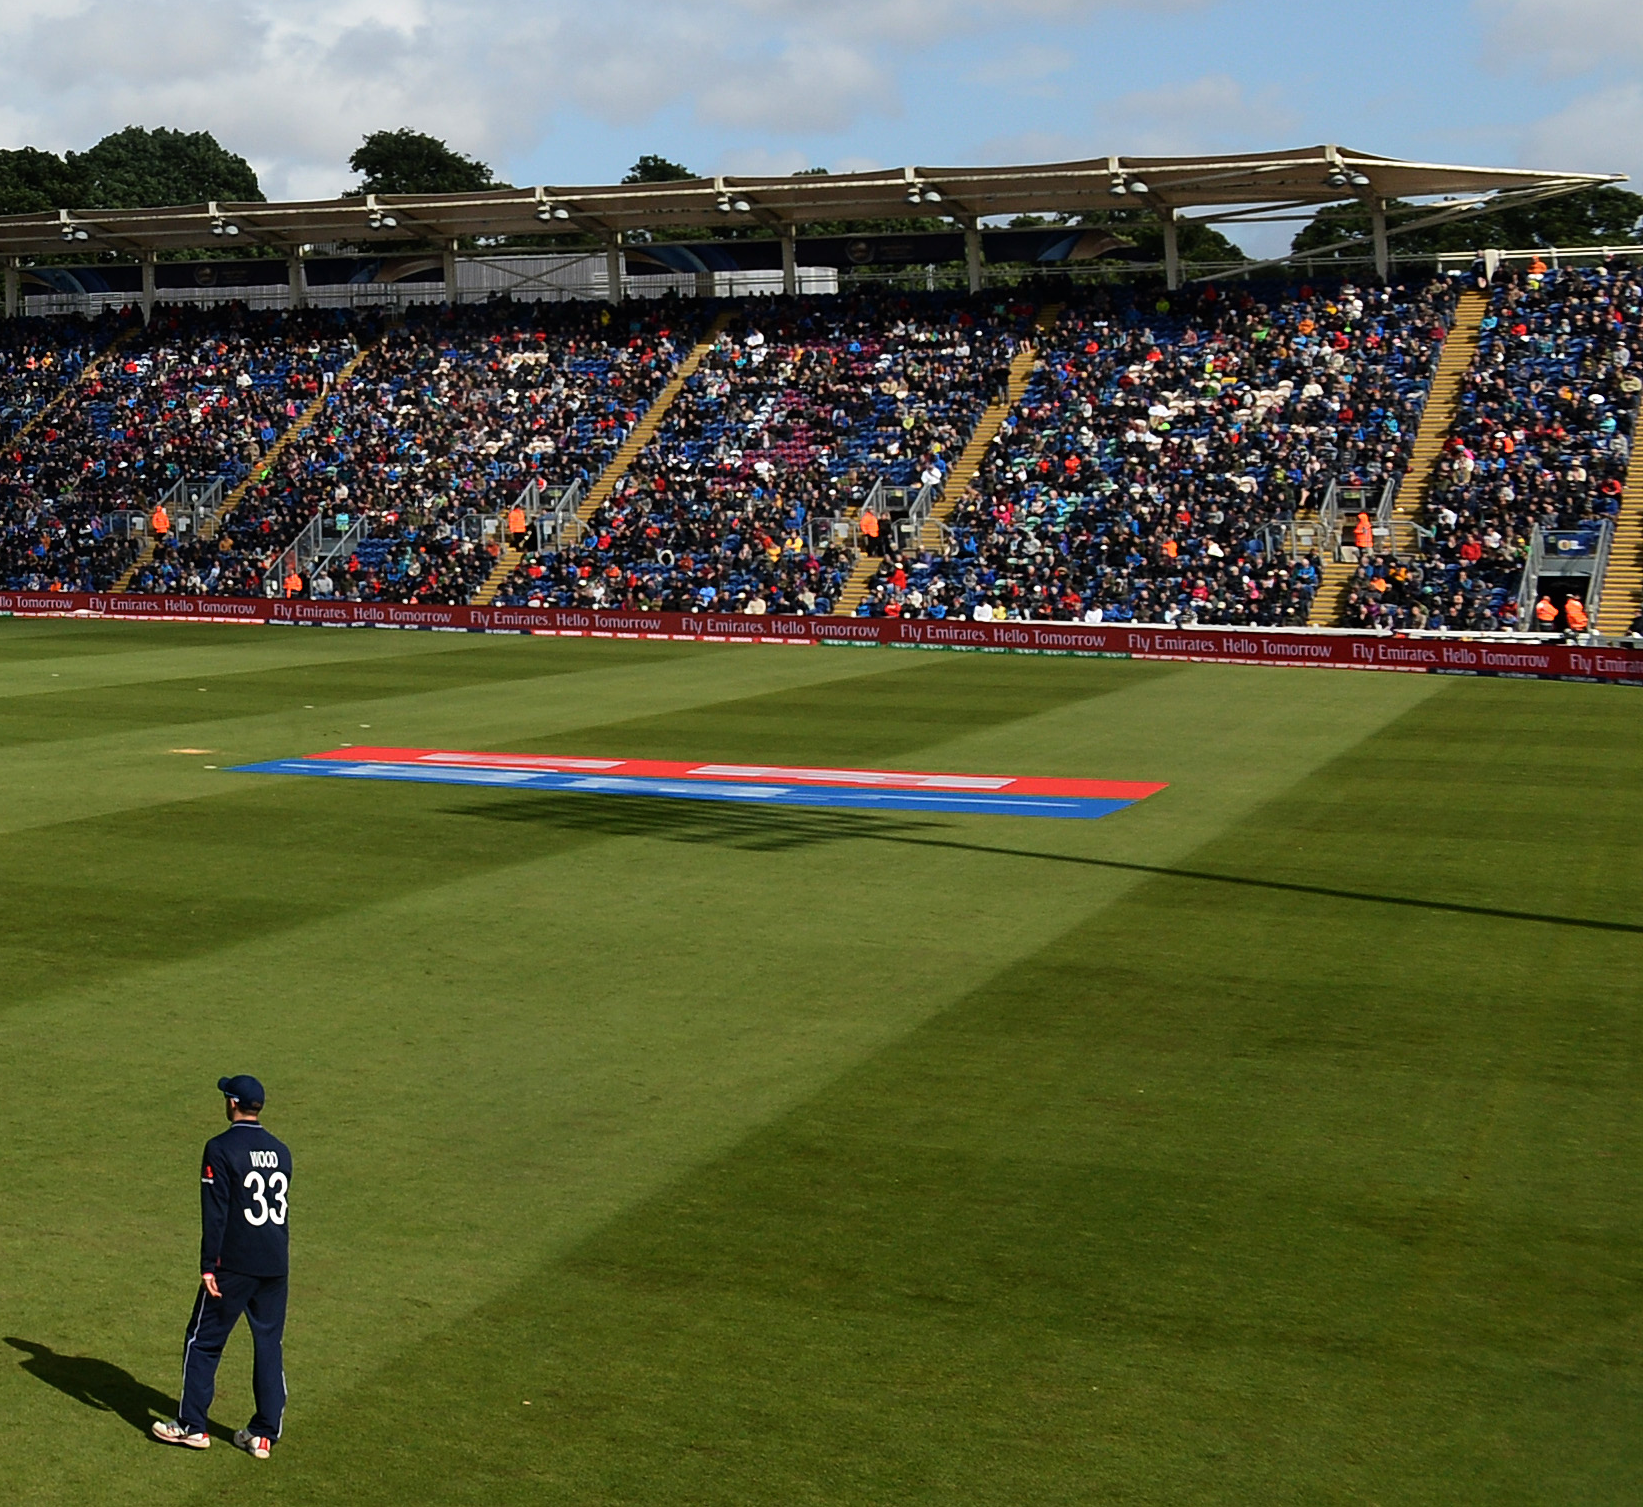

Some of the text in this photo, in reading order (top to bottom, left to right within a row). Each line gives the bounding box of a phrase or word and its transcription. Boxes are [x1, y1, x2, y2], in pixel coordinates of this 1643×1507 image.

[16, 596, 73, 608] Tomorrow
[90, 597, 106, 613] Fly
[165, 599, 193, 612] Hello
[197, 600, 256, 614] Tomorrow
[274, 603, 292, 619] Fly
[354, 606, 384, 620] Hello
[388, 608, 451, 622] Tomorrow
[471, 610, 488, 627] Fly
[556, 614, 589, 628] Hello
[592, 616, 661, 630] Tomorrow
[682, 618, 701, 635] Fly
[771, 621, 804, 636] Hello
[809, 623, 879, 638] Tomorrow
[901, 626, 921, 643] Fly
[994, 629, 1028, 644] Hello
[1034, 631, 1106, 647] Tomorrow
[1129, 634, 1150, 653] Fly
[1223, 638, 1257, 653] Hello
[1262, 641, 1331, 657] Tomorrow
[1353, 644, 1374, 662] Fly
[1443, 649, 1476, 663] Hello
[1480, 652, 1549, 667] Tomorrow
[1570, 655, 1592, 674] Fly
[249, 1151, 278, 1168] WOOD
[243, 1171, 288, 1226] 33
